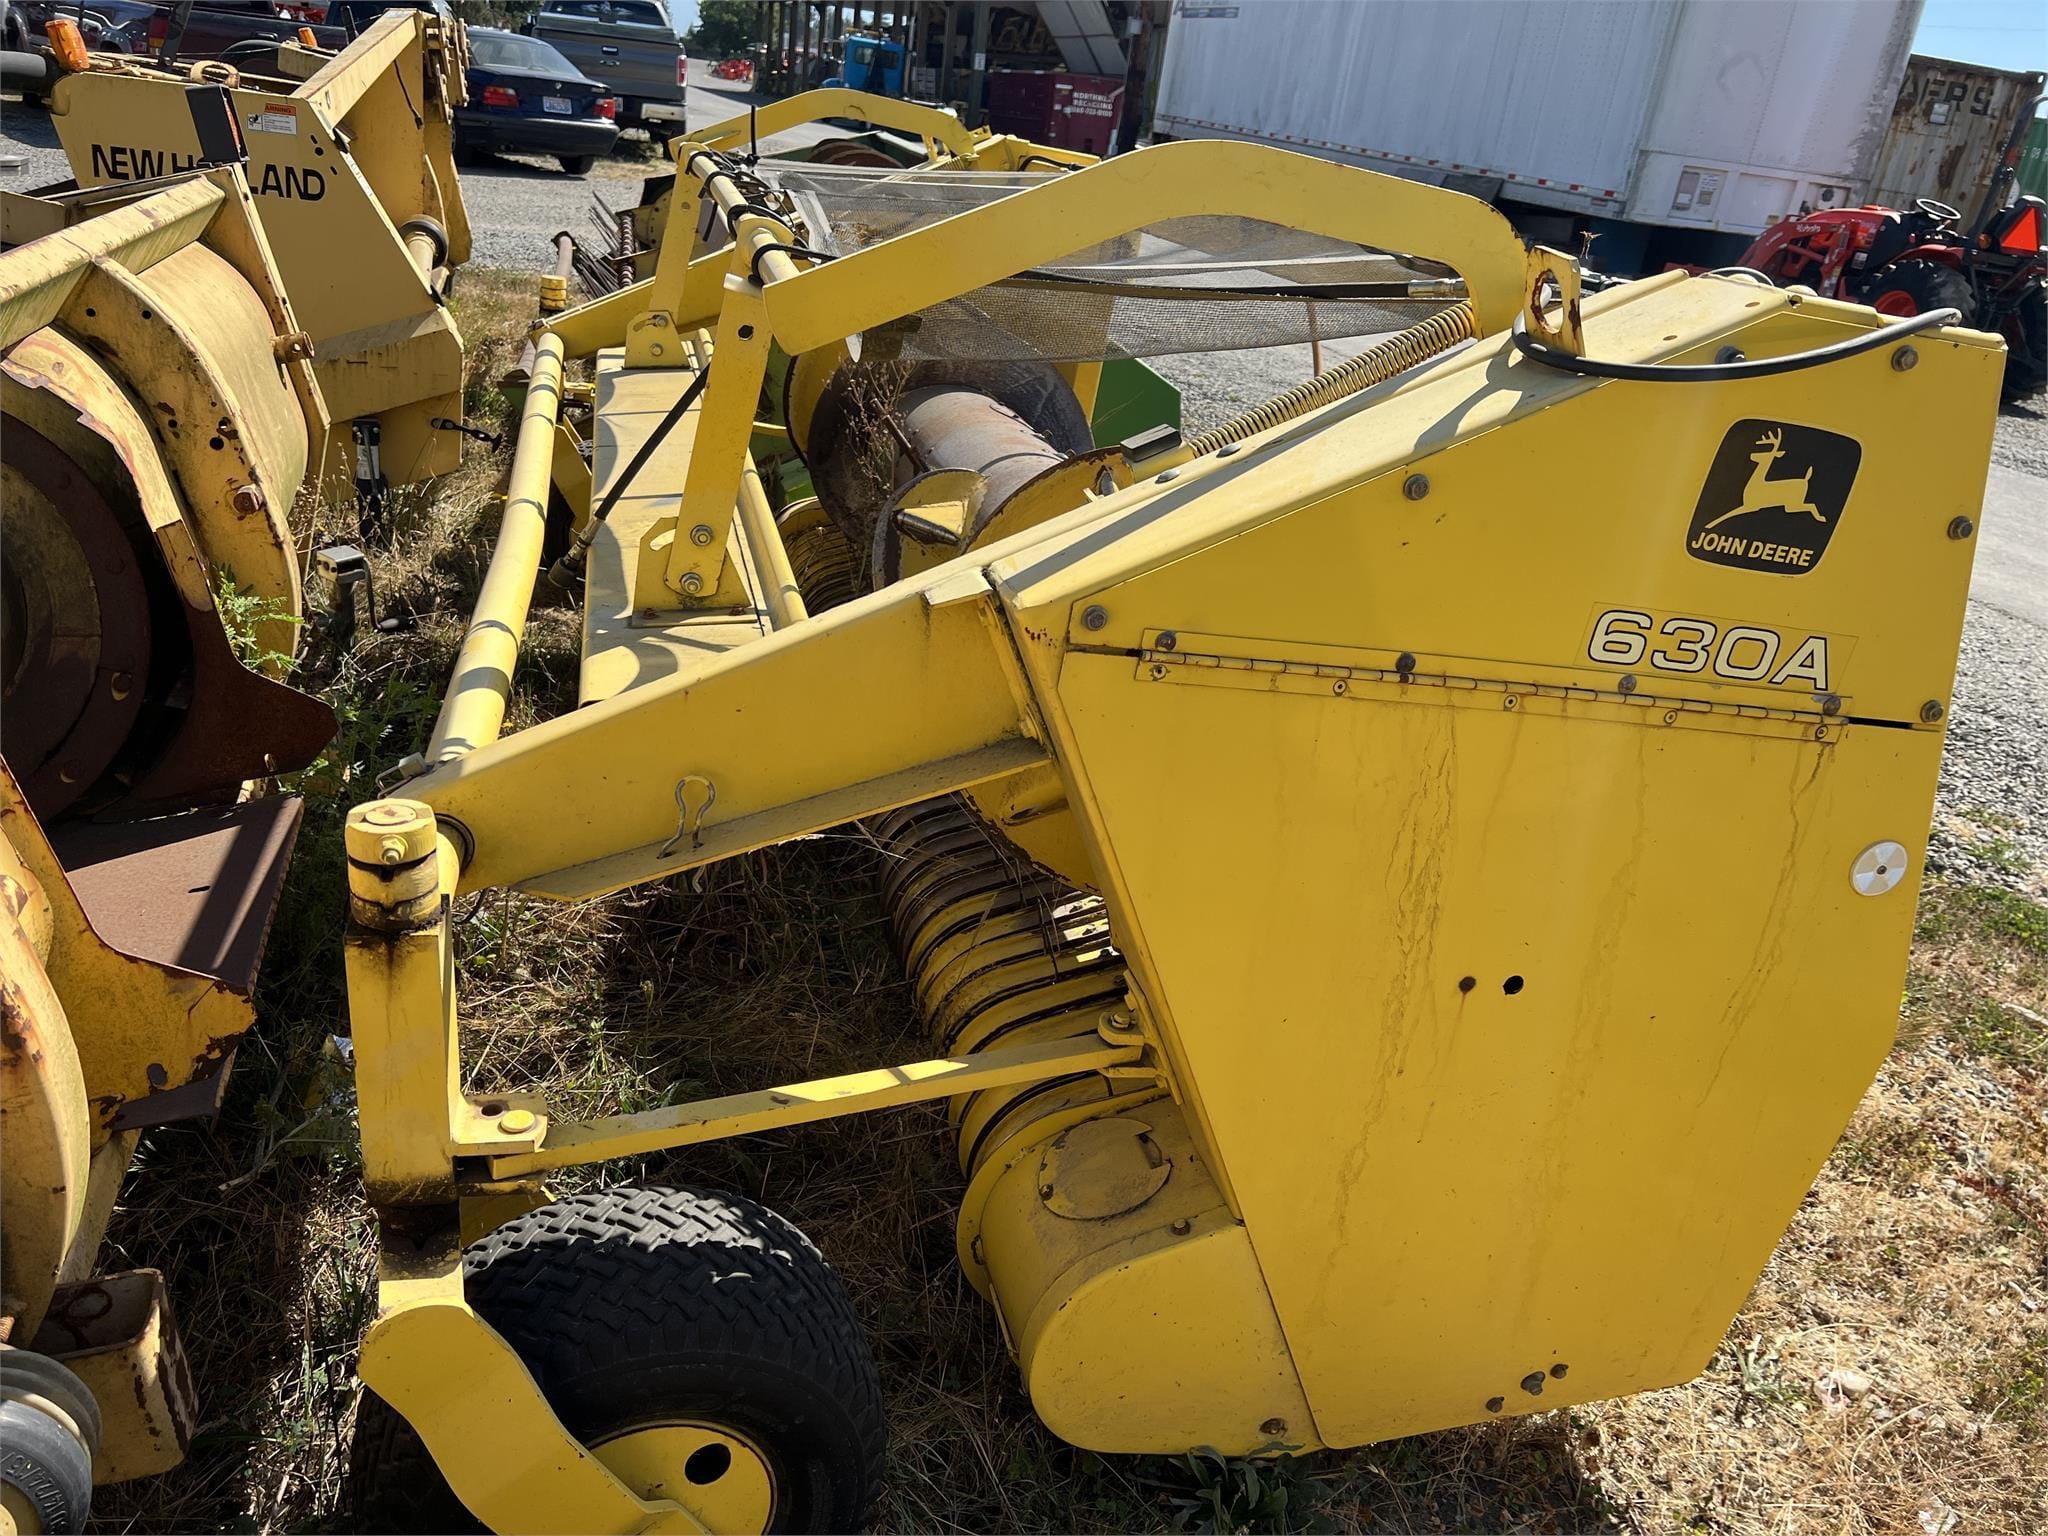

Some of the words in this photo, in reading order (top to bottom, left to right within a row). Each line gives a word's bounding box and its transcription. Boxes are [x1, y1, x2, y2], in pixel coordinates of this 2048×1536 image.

[91, 143, 163, 180] NEW
[171, 152, 325, 202] HLAND
[1691, 532, 1747, 556] JOHN
[1748, 541, 1814, 567] DEERE
[1588, 609, 1829, 692] 630A
